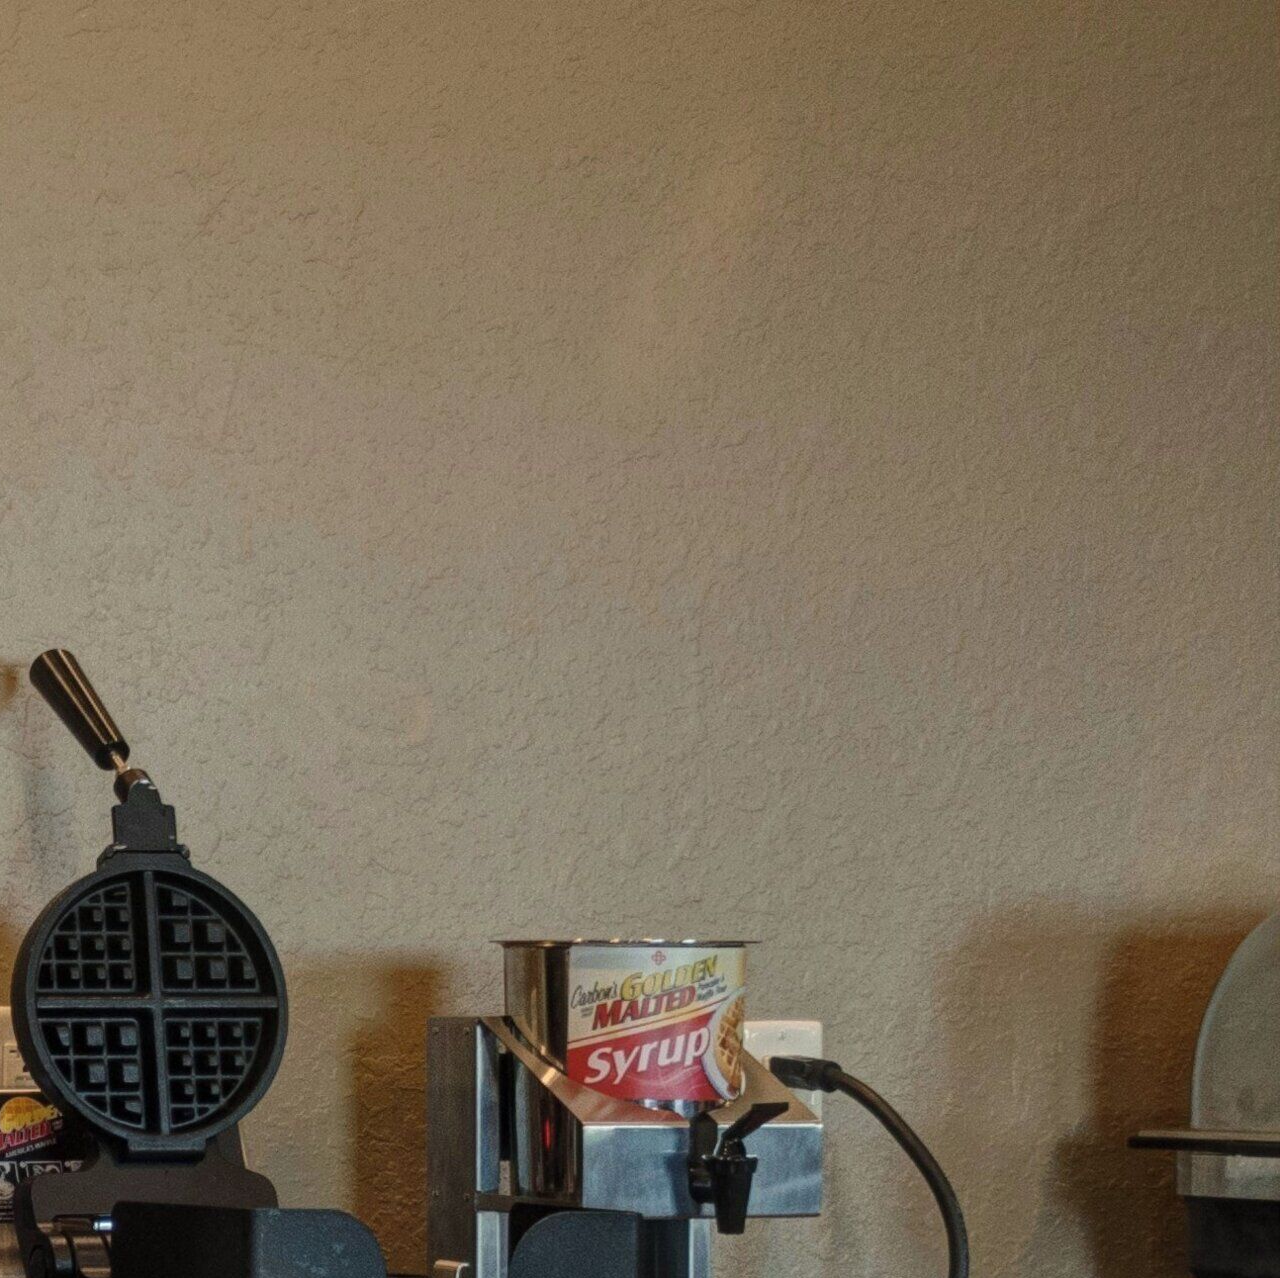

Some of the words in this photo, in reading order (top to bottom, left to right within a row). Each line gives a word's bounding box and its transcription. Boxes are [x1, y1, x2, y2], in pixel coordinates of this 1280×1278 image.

[620, 954, 718, 1001] GOLDEN
[592, 985, 697, 1031] MALTED
[584, 1026, 710, 1085] Syrup
